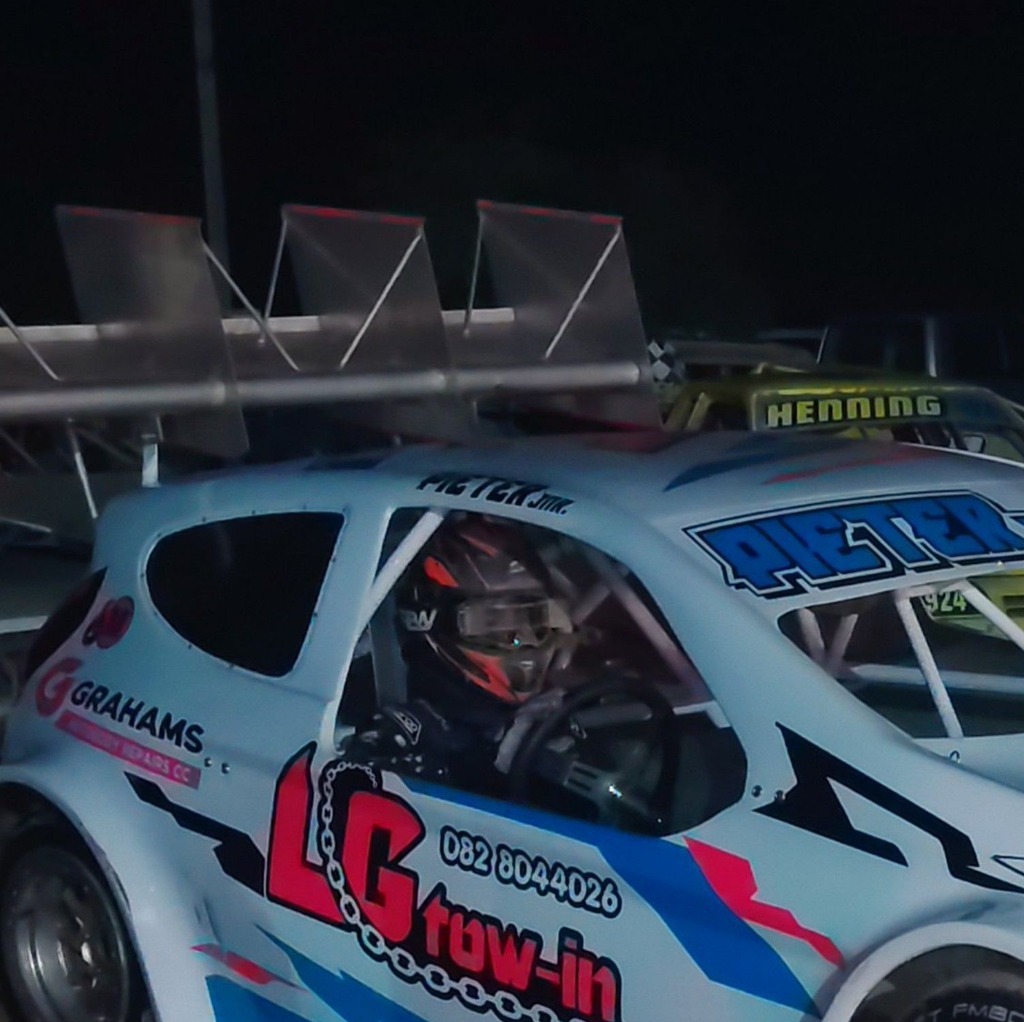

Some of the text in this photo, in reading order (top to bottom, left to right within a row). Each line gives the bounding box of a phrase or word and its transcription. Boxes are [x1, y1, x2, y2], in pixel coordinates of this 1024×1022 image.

[767, 395, 942, 428] HENNING
[71, 681, 204, 753] GRAHAMS
[265, 741, 425, 943] LG
[442, 828, 621, 916] 082 8044026
